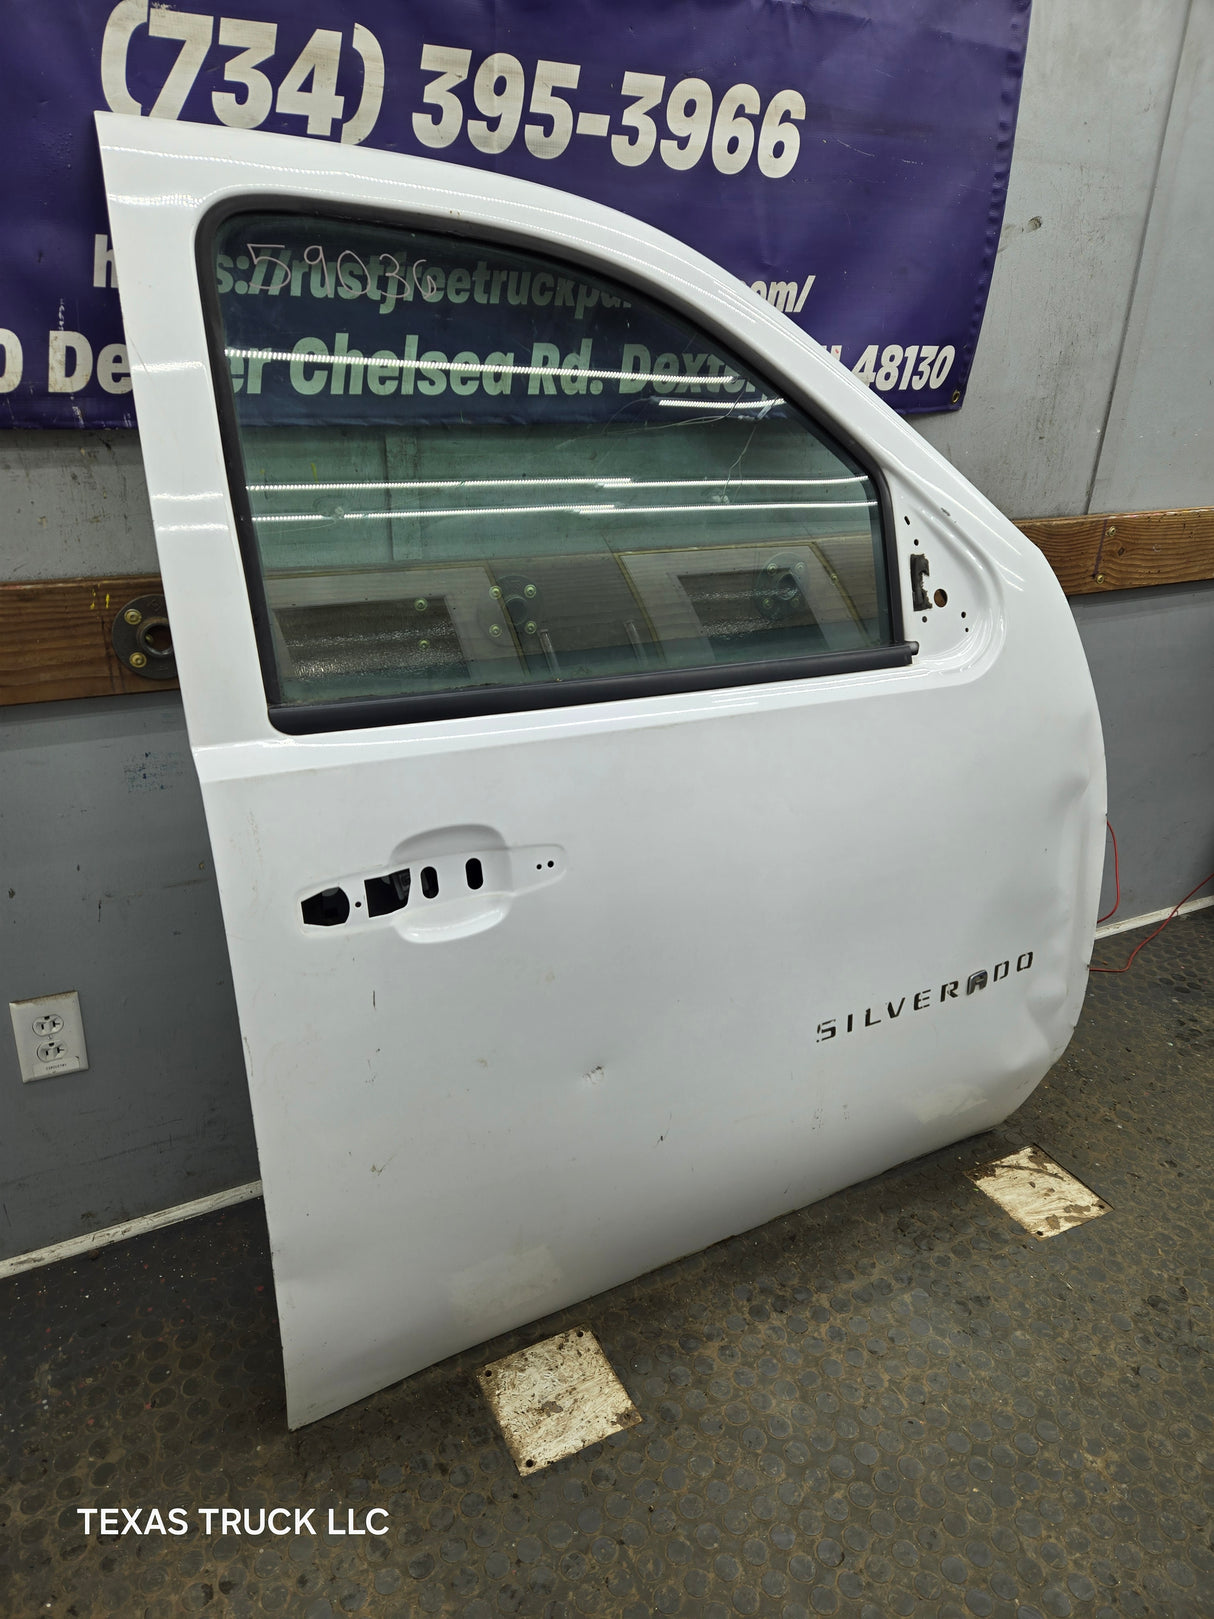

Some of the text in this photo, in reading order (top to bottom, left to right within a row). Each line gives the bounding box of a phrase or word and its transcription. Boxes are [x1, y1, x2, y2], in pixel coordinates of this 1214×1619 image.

[101, 0, 806, 179] (734) 395-3966
[247, 243, 438, 300] 59036
[290, 332, 516, 396] Chelsea
[527, 340, 603, 396] Rd.
[851, 345, 956, 391] 48130
[816, 951, 1034, 1043] SILVERADO
